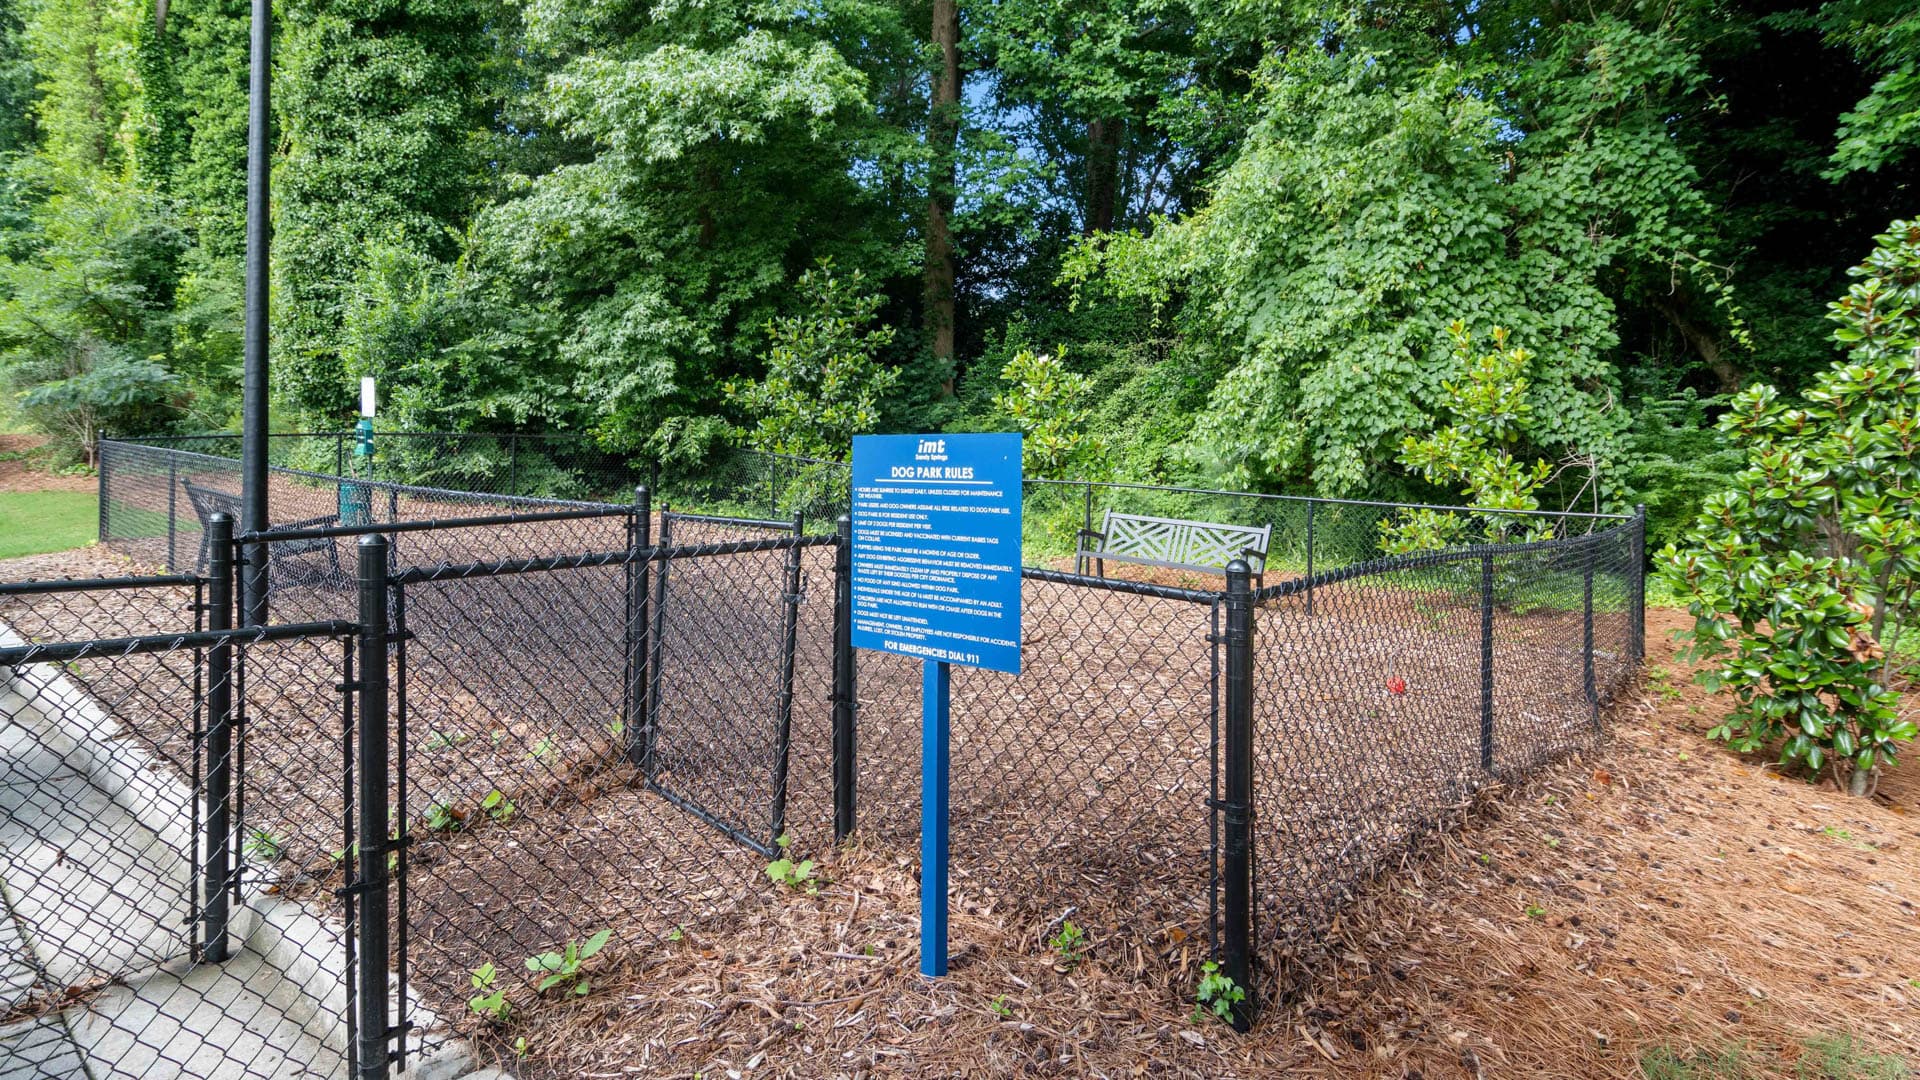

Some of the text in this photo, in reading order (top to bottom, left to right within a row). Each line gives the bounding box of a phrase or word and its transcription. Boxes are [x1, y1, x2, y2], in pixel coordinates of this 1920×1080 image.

[918, 440, 945, 453] imt
[892, 466, 973, 479] DOG PARK RULES
[885, 640, 979, 664] FOR EMERGENCIES DIAL 911
